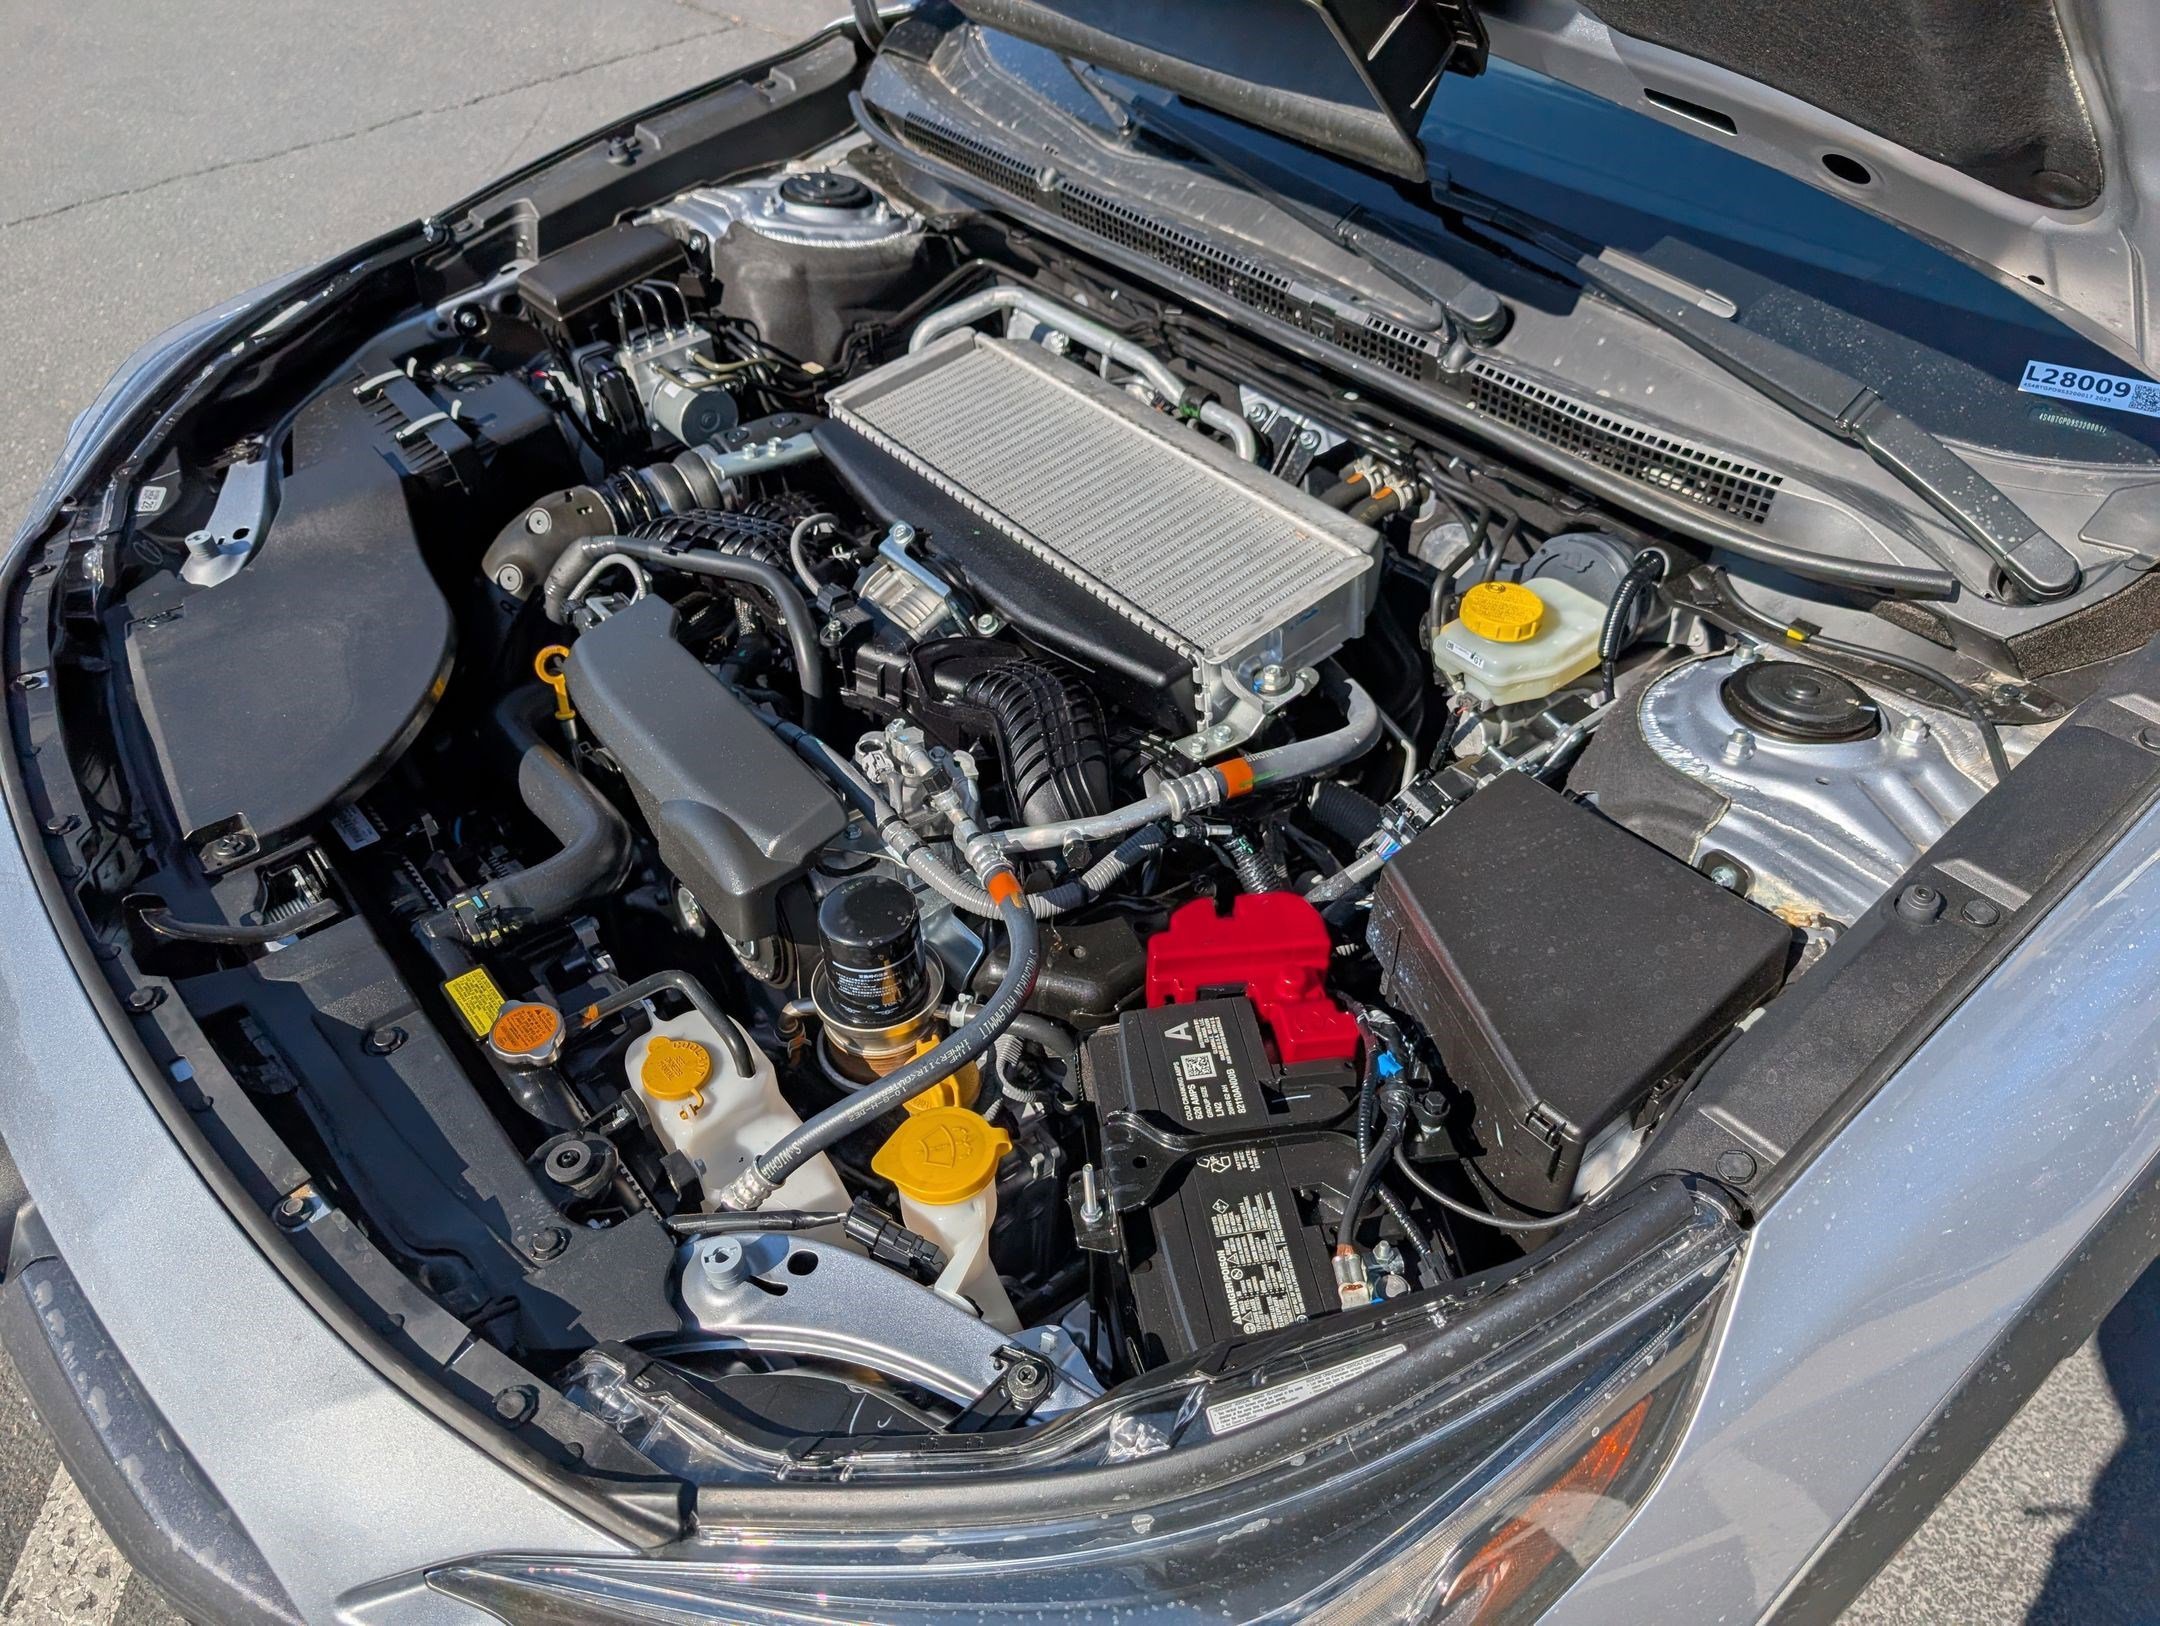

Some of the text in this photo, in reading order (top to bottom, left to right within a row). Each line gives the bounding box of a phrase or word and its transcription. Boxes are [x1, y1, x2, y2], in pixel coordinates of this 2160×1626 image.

[2026, 366, 2131, 398] L28009
[1164, 1022, 1192, 1042] A
[1172, 1061, 1193, 1120] COLD CRANKING AMPS
[1187, 1083, 1203, 1119] 620 AMPS
[1199, 1085, 1213, 1117] GROUP SIZE
[1226, 1068, 1246, 1113] 82110AN00B
[1213, 1101, 1224, 1116] LN2
[1216, 1249, 1239, 1316] DANGER/POISON
